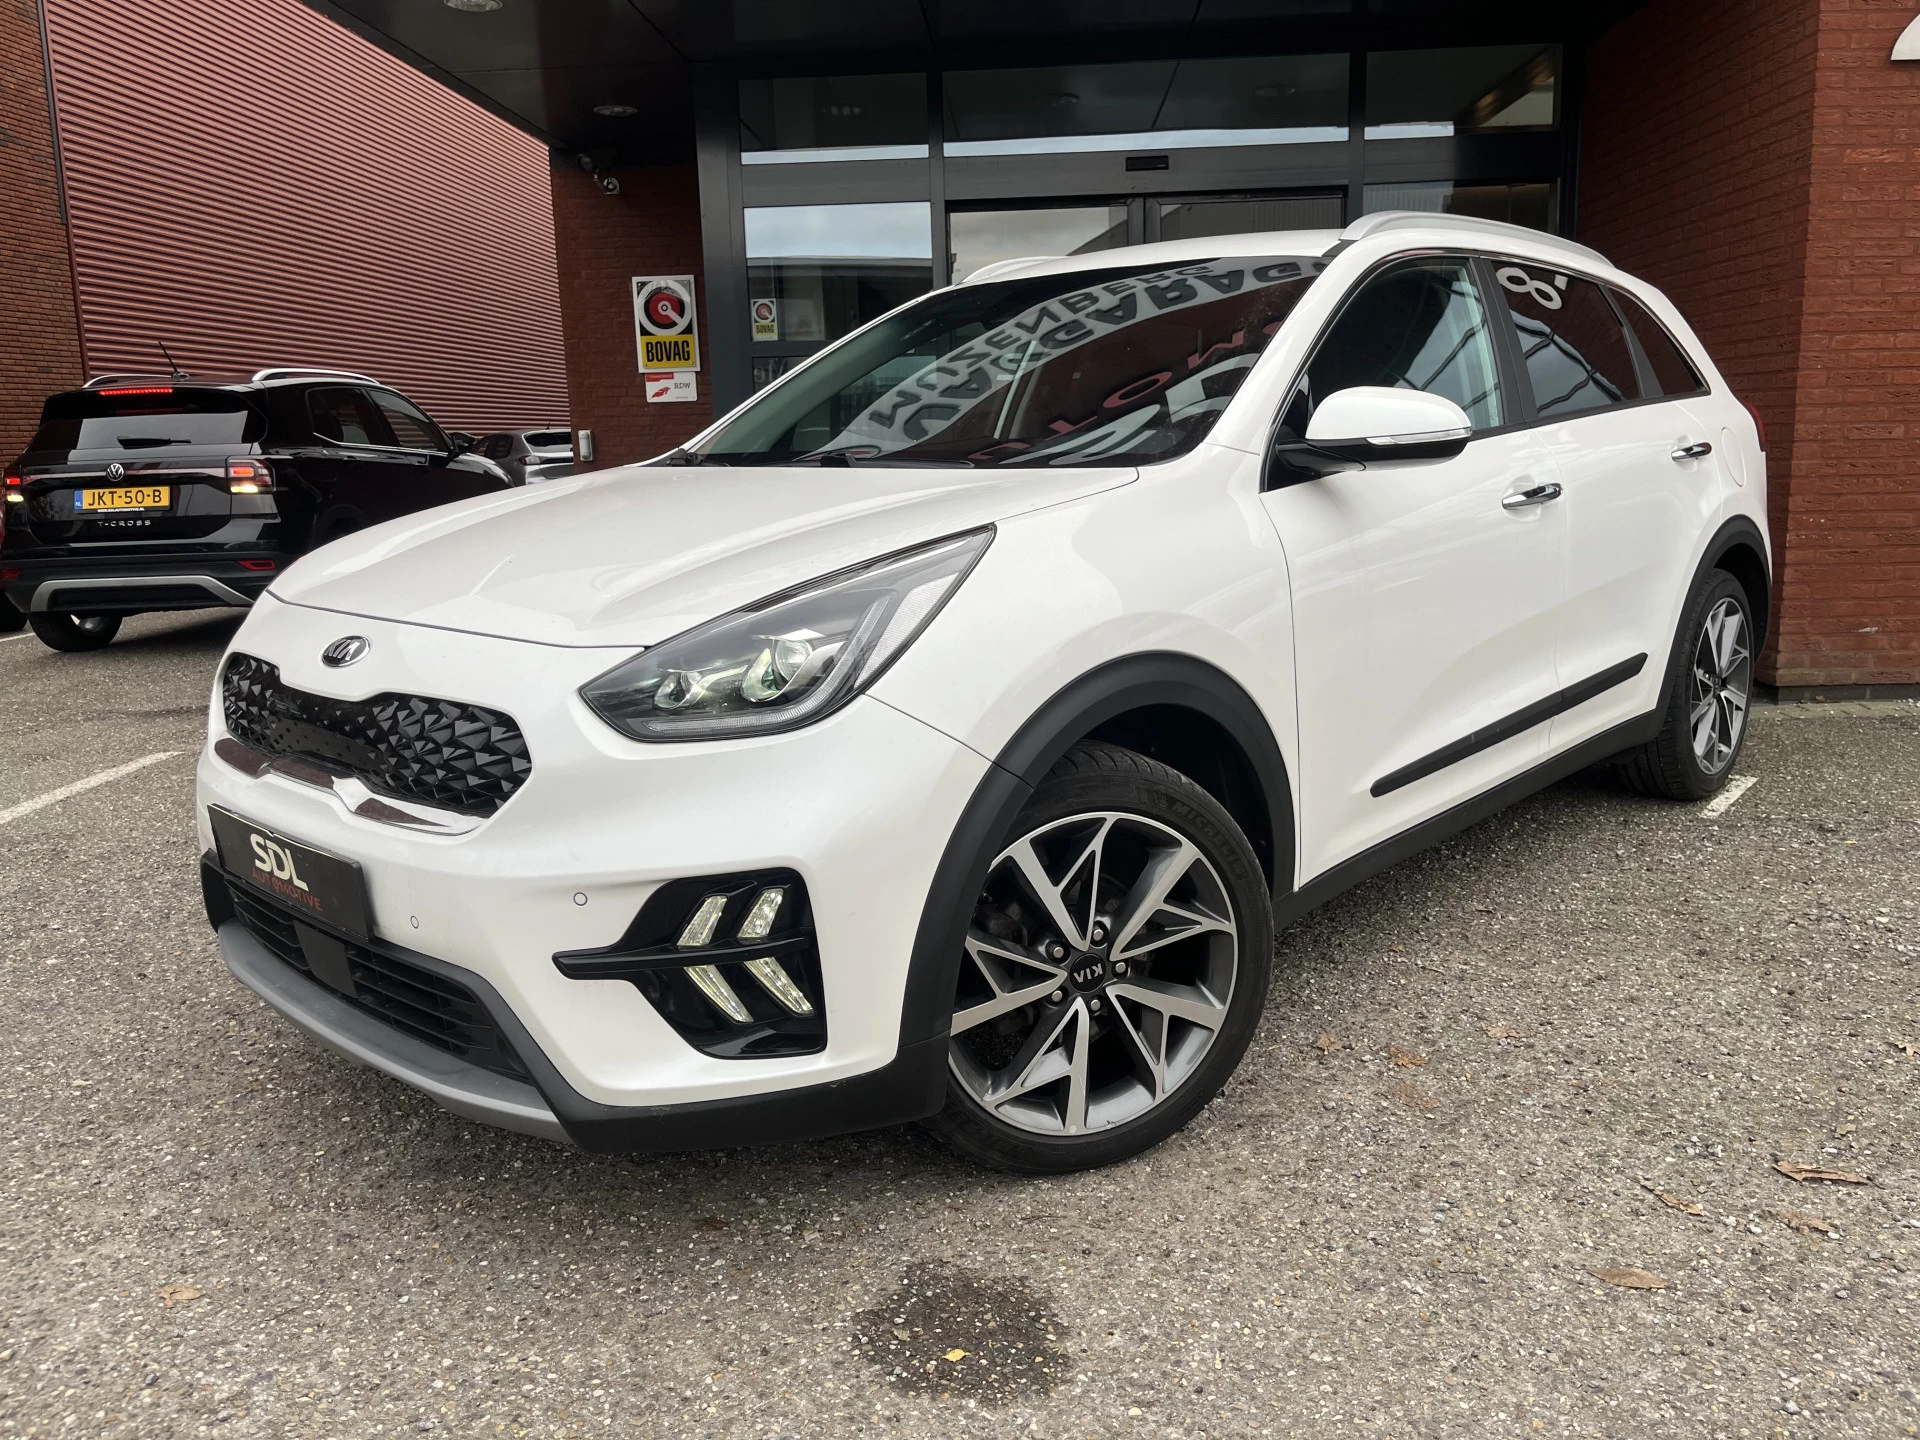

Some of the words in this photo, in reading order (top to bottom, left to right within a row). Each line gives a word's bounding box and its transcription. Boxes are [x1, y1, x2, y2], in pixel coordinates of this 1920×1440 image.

[755, 324, 775, 334] BOVAG
[645, 340, 691, 363] BOVAG
[87, 489, 162, 506] JKT-50-B
[250, 833, 309, 892] SDL
[252, 867, 324, 912] AUTOMOTIVE
[1073, 963, 1104, 984] KIA
